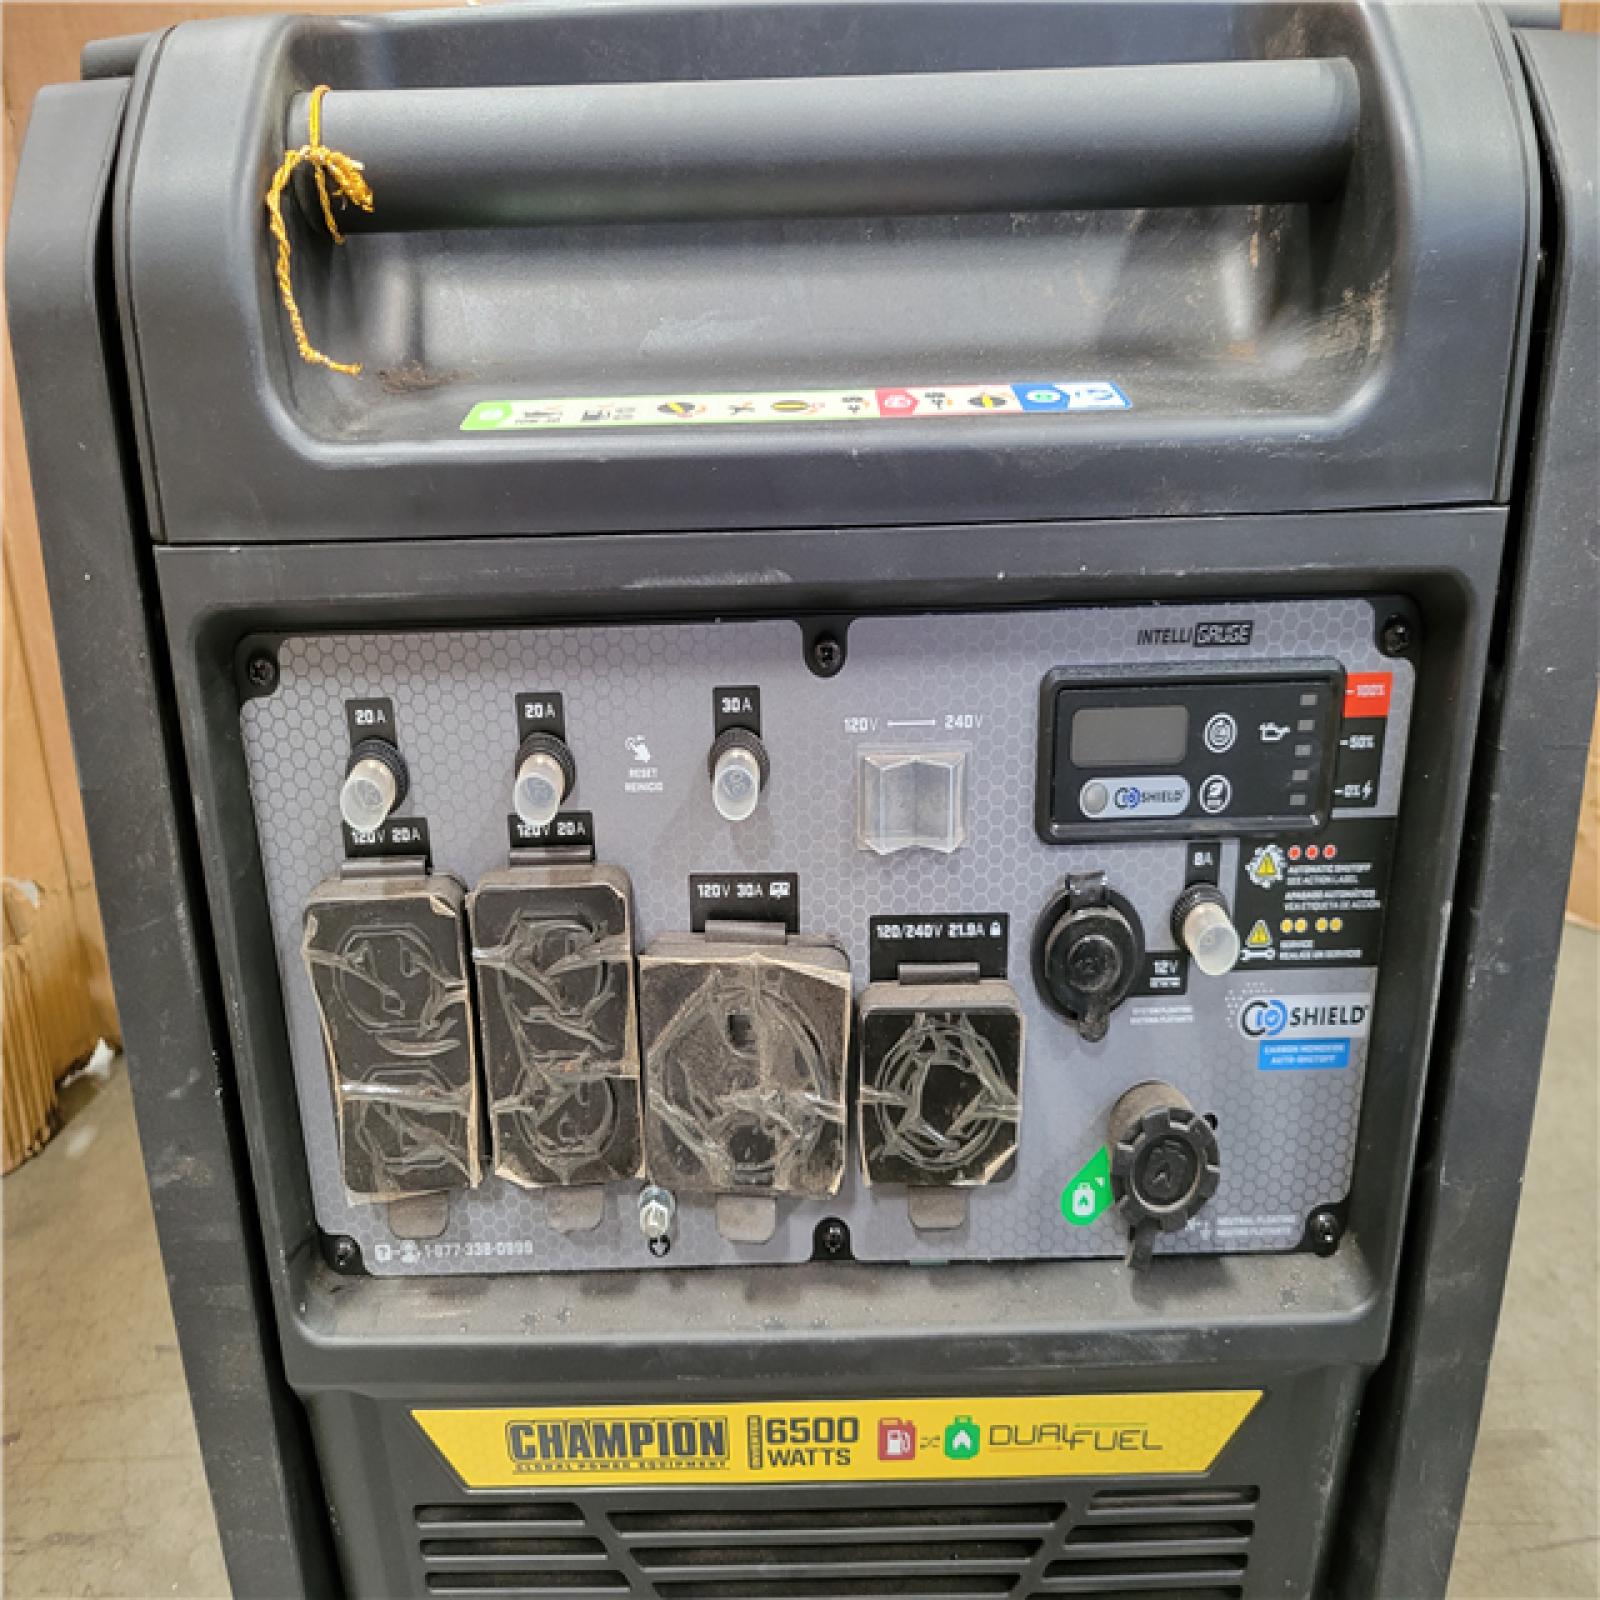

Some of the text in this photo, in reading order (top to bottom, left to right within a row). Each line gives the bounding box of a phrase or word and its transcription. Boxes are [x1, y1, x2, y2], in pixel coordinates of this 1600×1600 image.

[844, 717, 879, 733] 120V
[944, 714, 983, 729] 240V
[697, 883, 763, 898] 120V 30A
[1153, 959, 1179, 976] 12V
[1289, 1004, 1366, 1027] SHIELD
[765, 1415, 859, 1445] 6500
[508, 1419, 727, 1462] CHAMPION
[767, 1446, 851, 1467] WATTS
